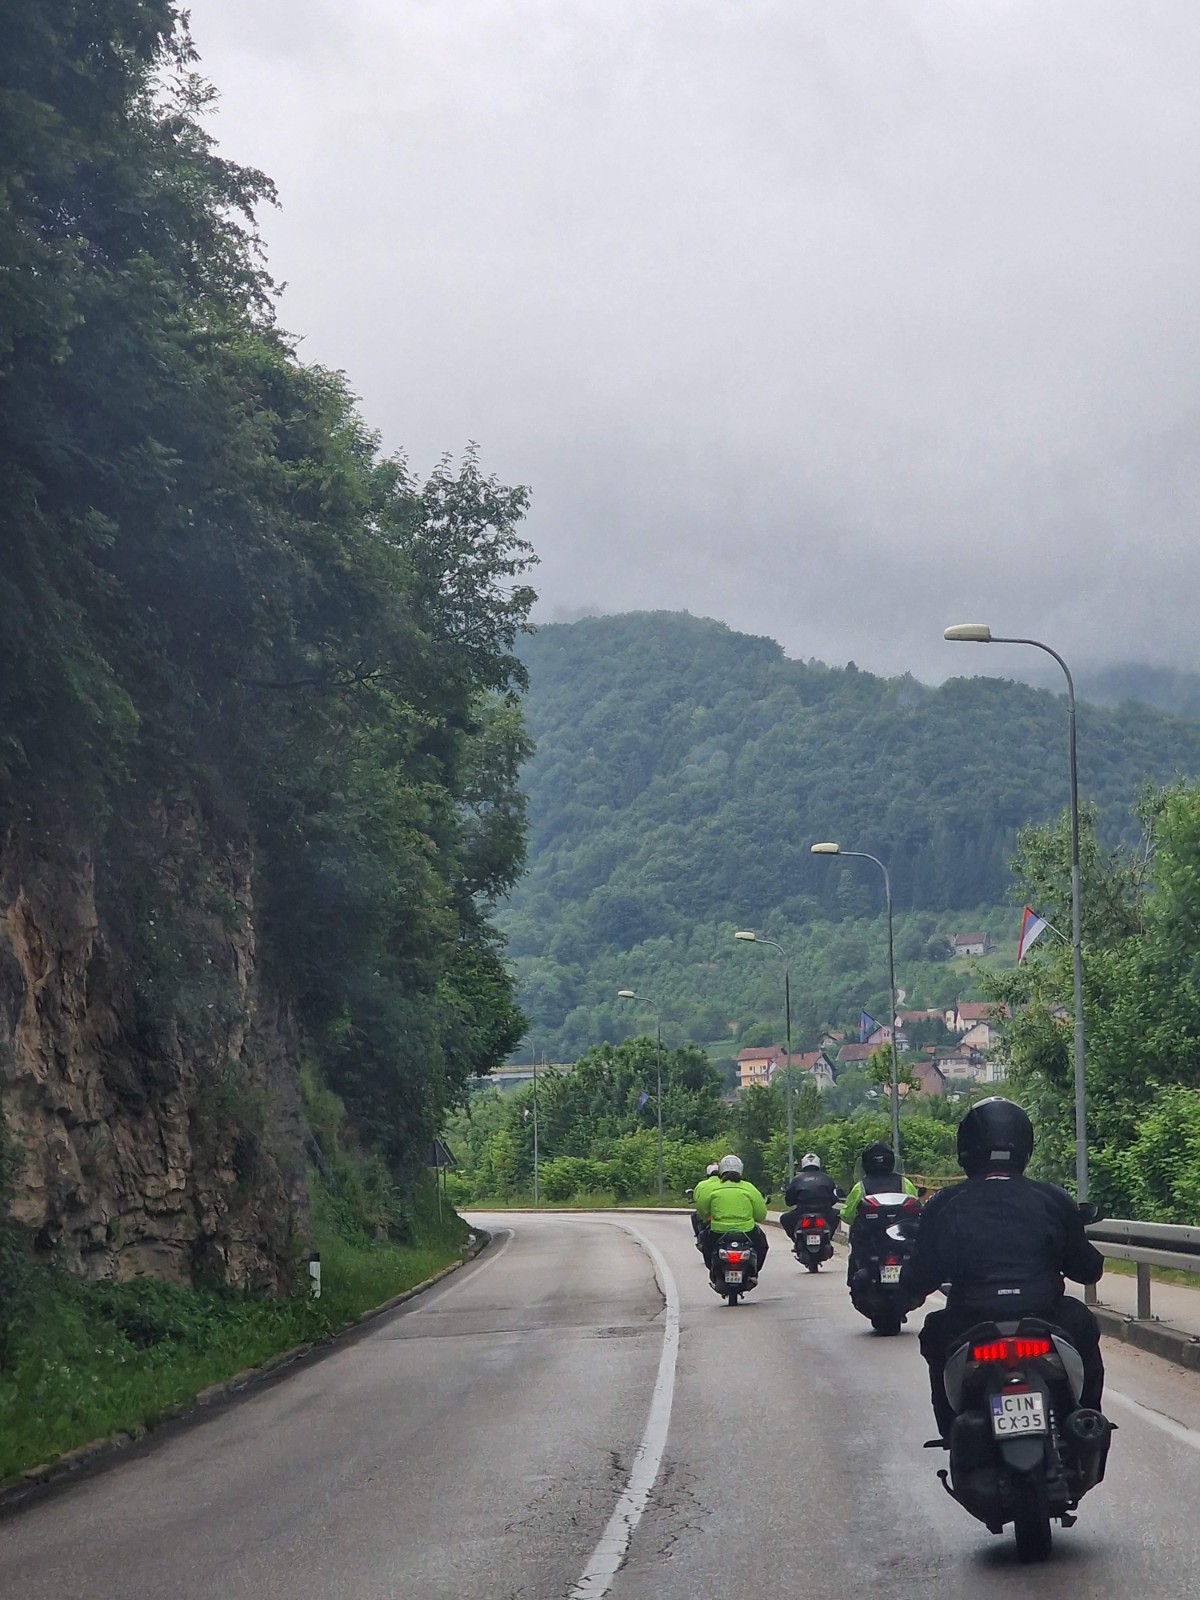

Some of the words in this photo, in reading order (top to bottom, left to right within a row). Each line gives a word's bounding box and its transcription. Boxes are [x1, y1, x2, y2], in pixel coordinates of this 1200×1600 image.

[993, 1407, 1003, 1415] PL
[1004, 1397, 1034, 1412] CIN
[997, 1413, 1042, 1430] CX35
